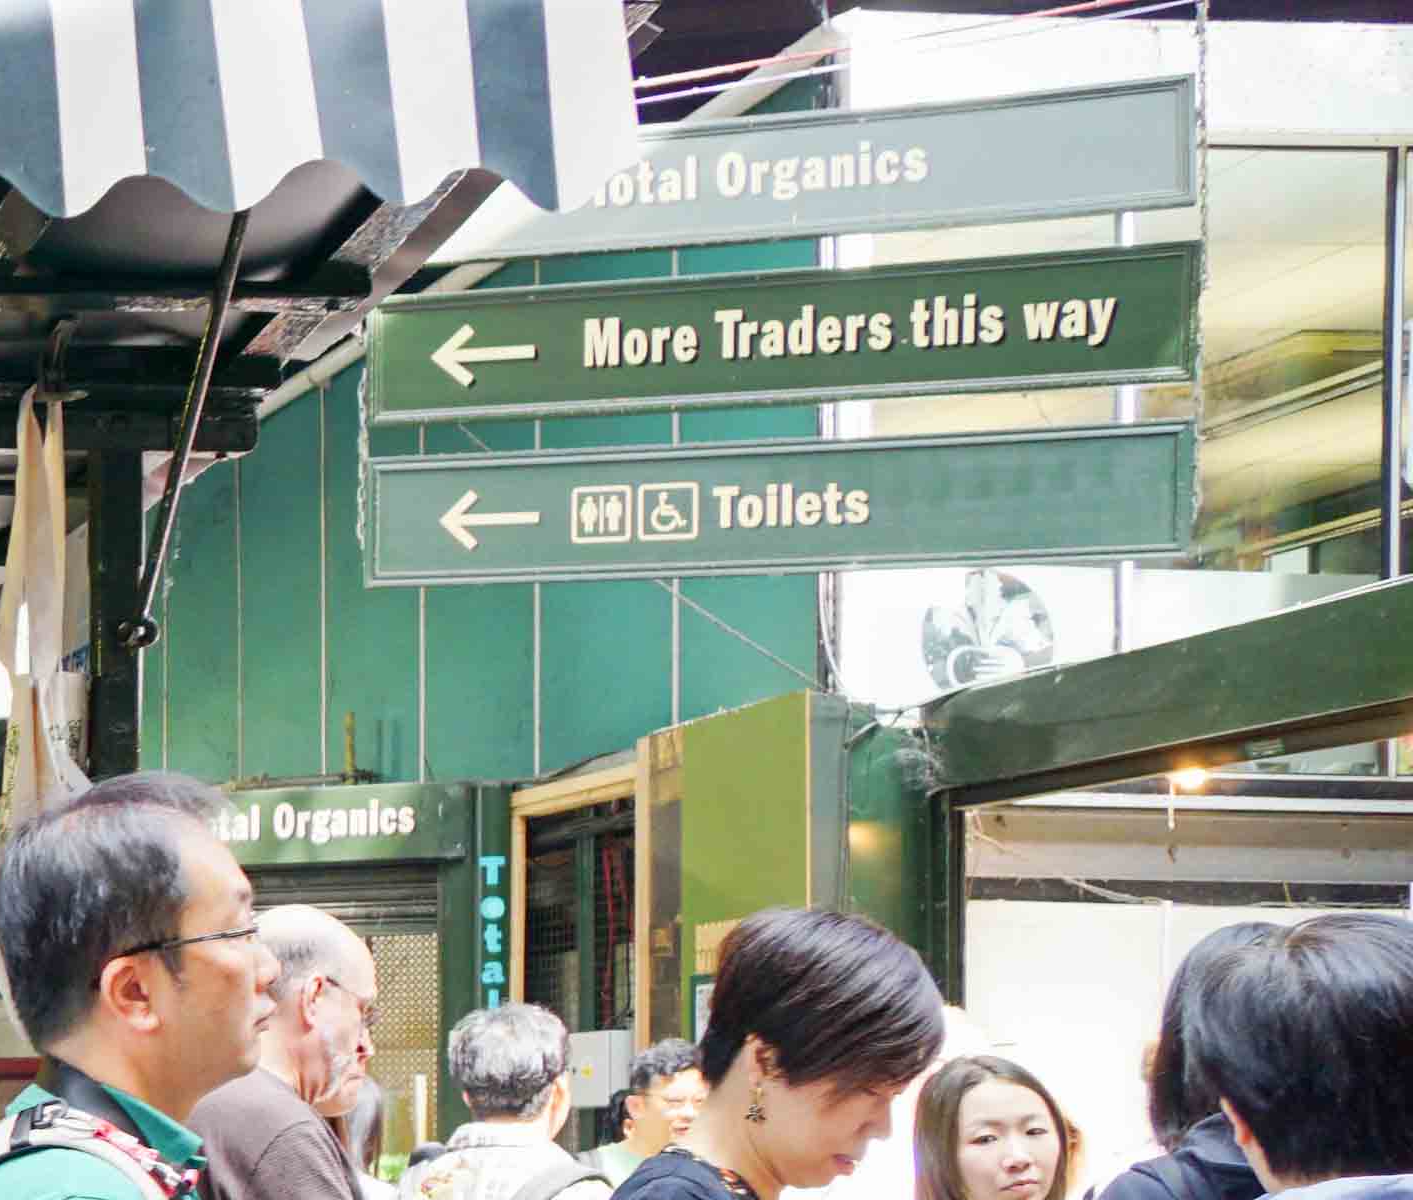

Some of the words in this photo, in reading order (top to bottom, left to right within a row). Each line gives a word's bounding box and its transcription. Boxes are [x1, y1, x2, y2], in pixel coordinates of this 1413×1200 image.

[716, 142, 930, 198] Organics
[583, 316, 700, 368] More
[714, 304, 894, 360] Traders
[910, 292, 1006, 347] this
[1023, 296, 1117, 349] way
[712, 482, 871, 530] Toilets
[273, 798, 416, 846] Organics
